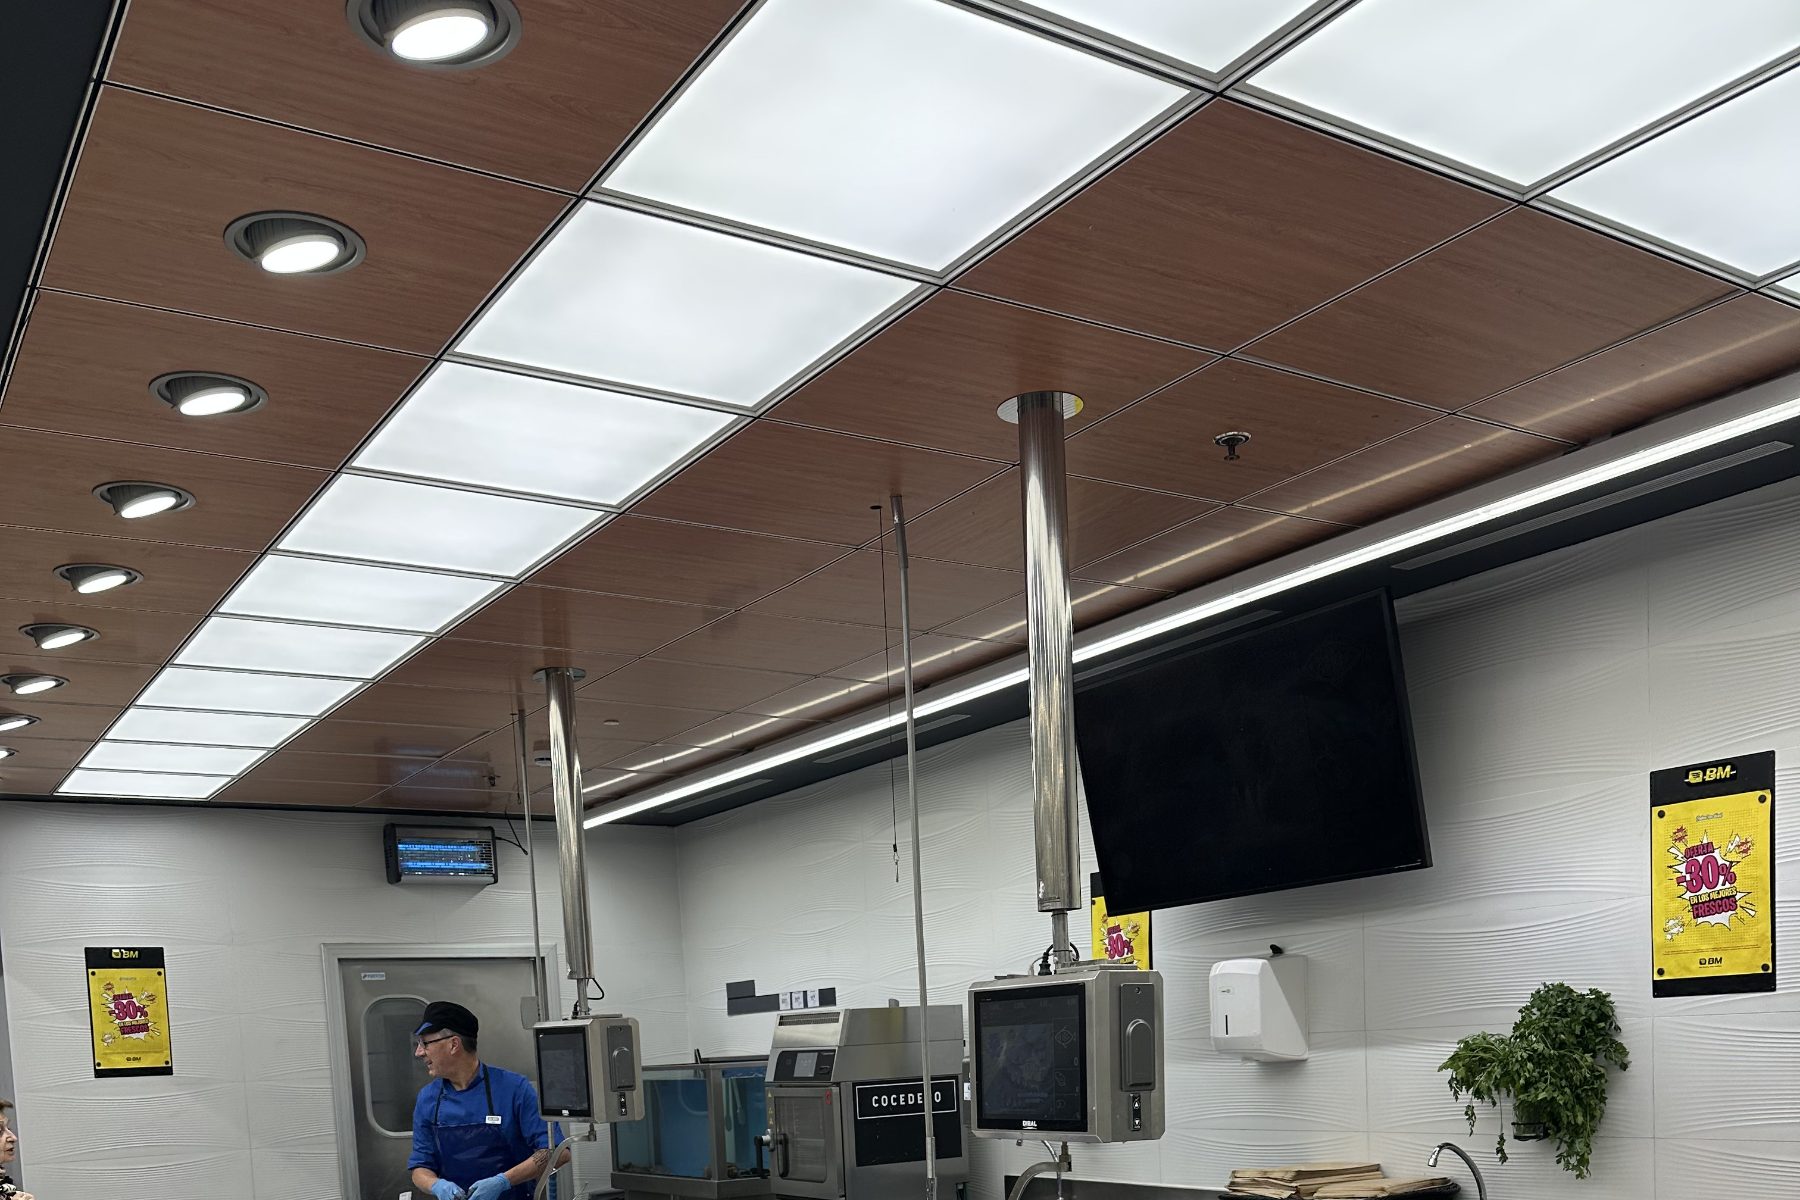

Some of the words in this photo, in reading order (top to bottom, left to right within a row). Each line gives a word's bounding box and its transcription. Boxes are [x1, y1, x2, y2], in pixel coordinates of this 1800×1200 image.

[1705, 765, 1731, 781] BM
[1684, 842, 1714, 859] OFERTA
[1676, 855, 1737, 893] -30%
[1698, 892, 1710, 903] LOS
[1710, 886, 1737, 899] MEJORES
[1692, 897, 1738, 918] FRESCOS
[123, 950, 139, 959] BM
[872, 1091, 941, 1108] COCEDEO
